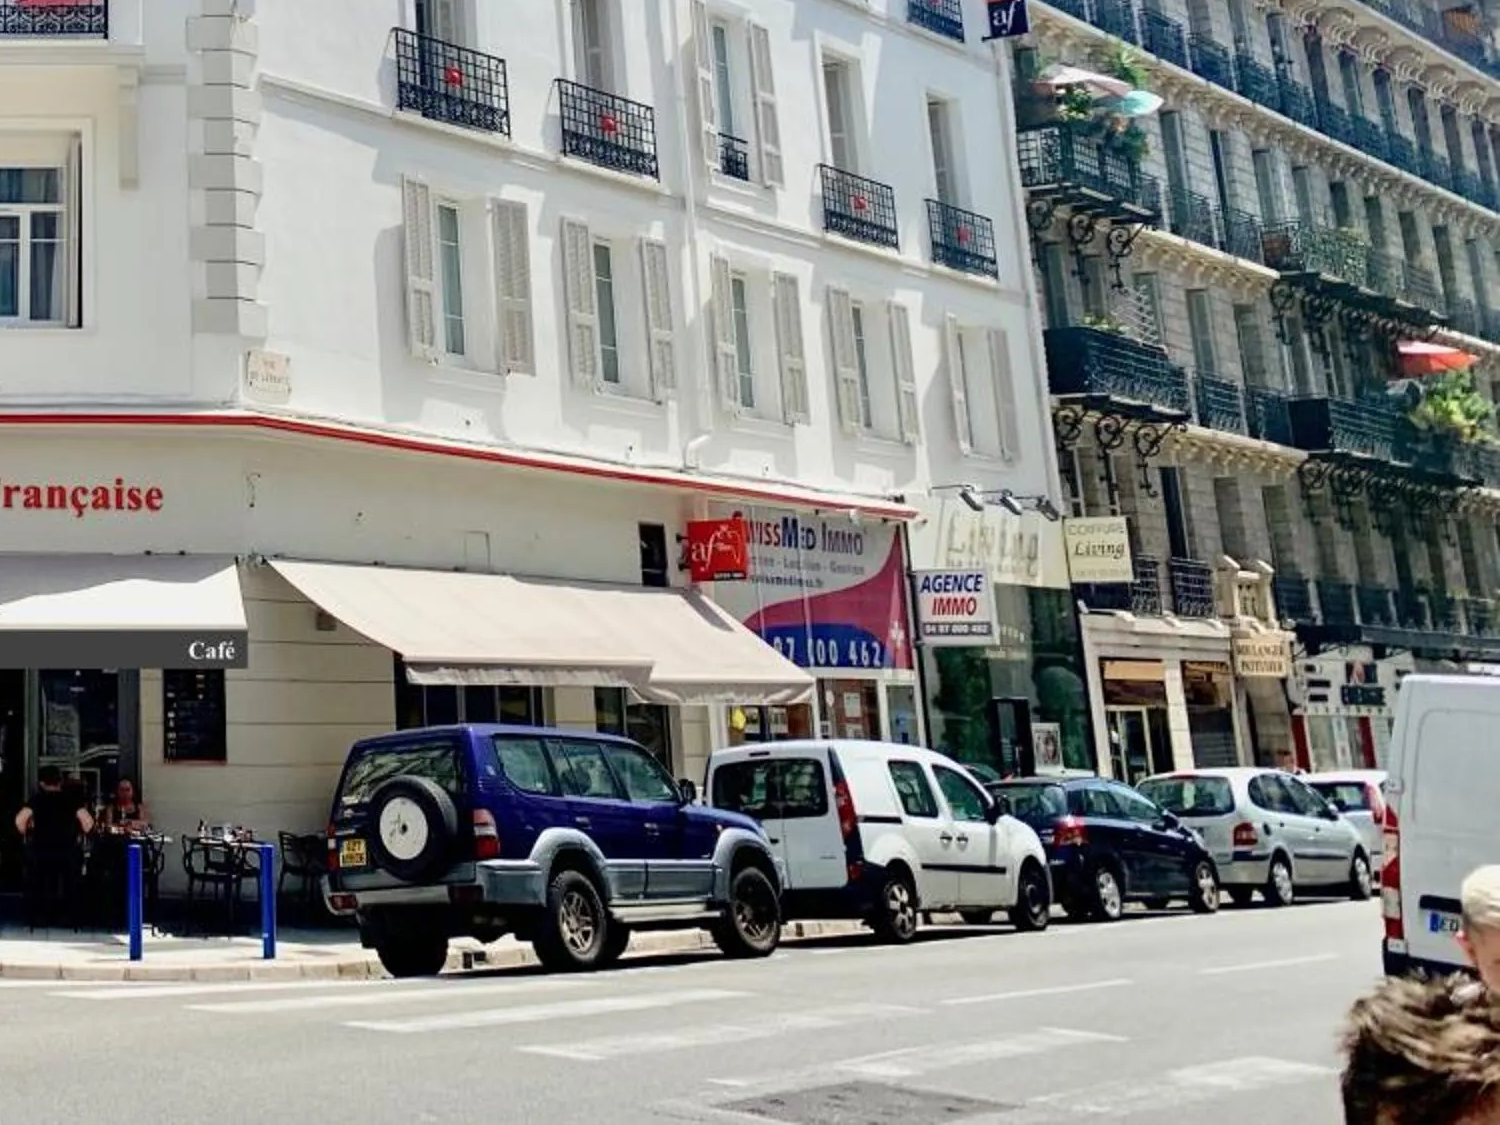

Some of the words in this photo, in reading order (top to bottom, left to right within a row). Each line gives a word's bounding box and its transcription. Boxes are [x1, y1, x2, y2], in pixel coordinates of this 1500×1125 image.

[1074, 540, 1125, 560] Living
[920, 574, 984, 593] AGENCE
[931, 597, 977, 616] IMMO
[188, 640, 236, 660] Café
[849, 639, 881, 666] 462
